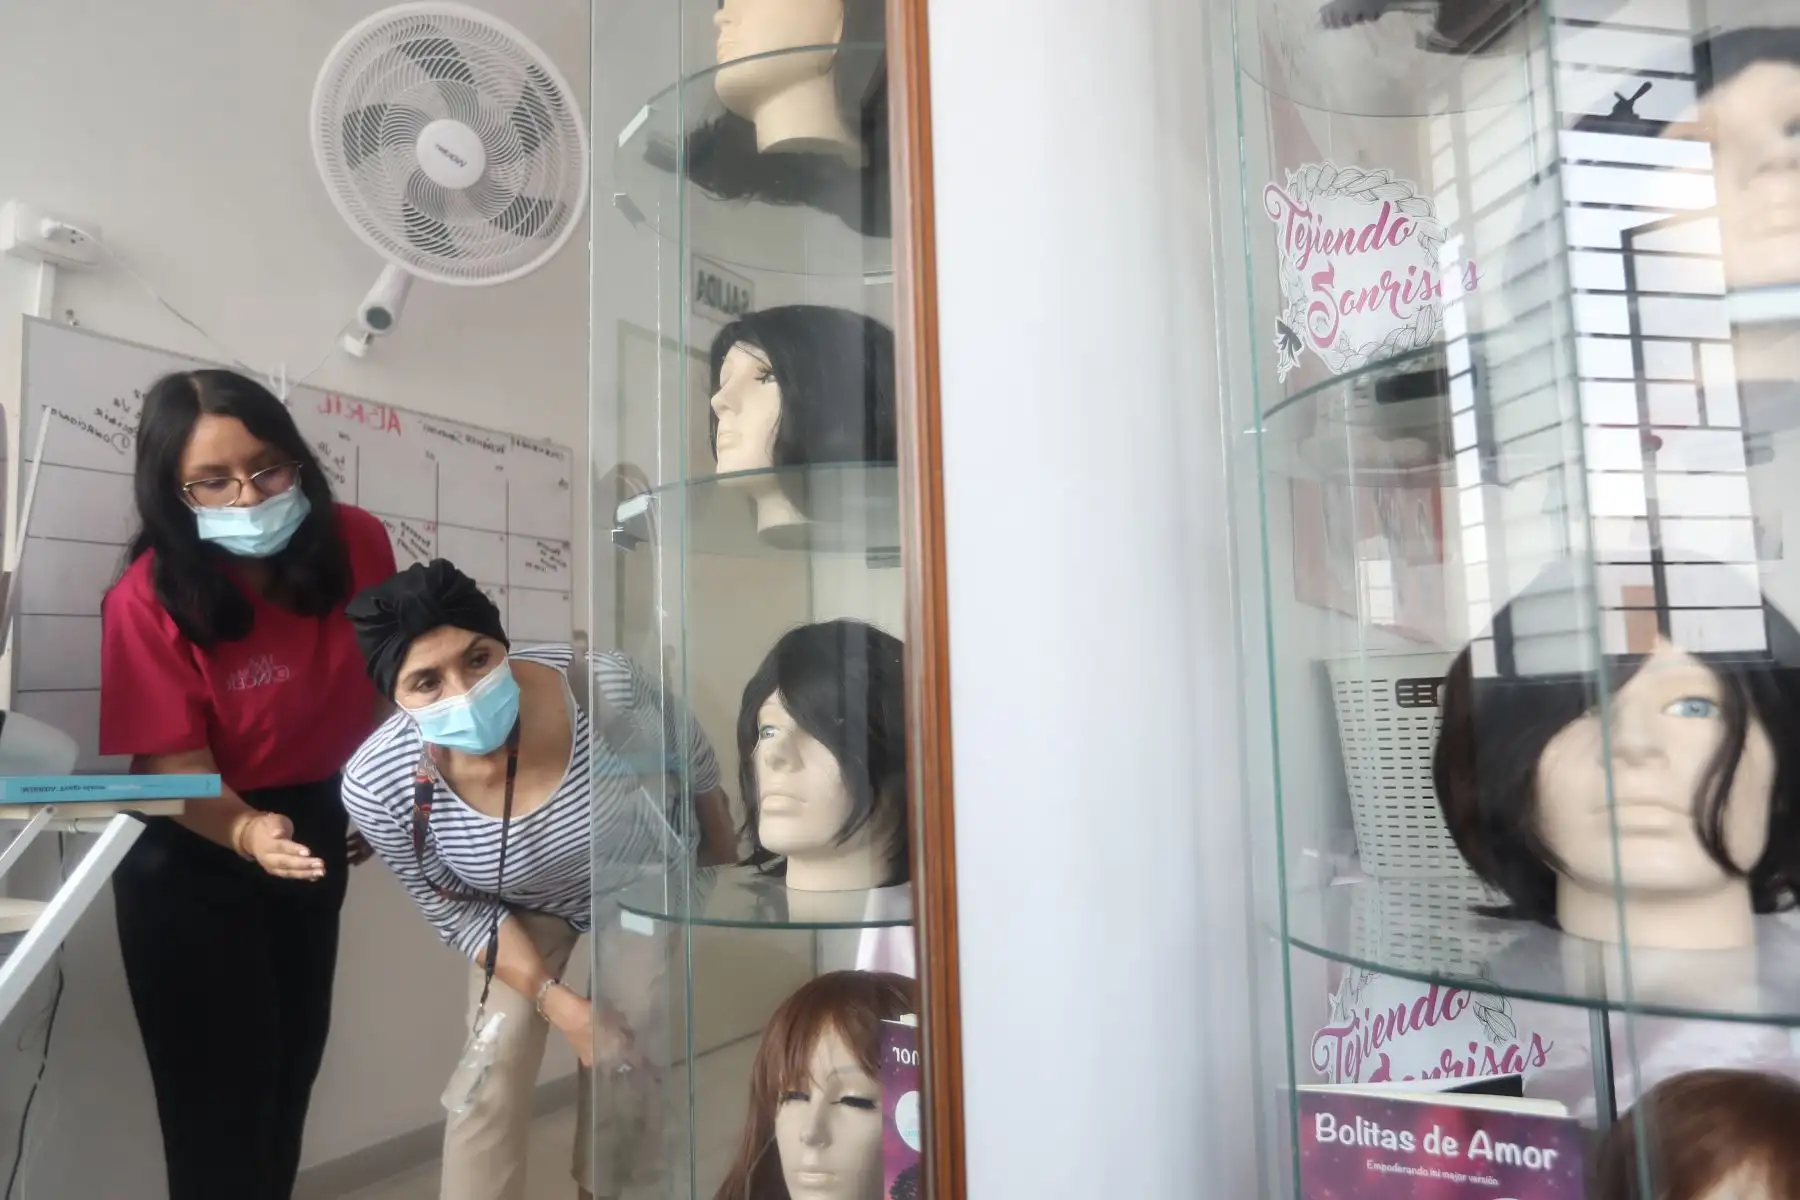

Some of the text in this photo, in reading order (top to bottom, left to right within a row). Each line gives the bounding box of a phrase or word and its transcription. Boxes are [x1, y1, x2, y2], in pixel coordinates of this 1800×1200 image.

[1265, 185, 1417, 269] Tejiendo
[1315, 1112, 1558, 1170] Bolitas de Amor
[1430, 1168, 1441, 1178] mi
